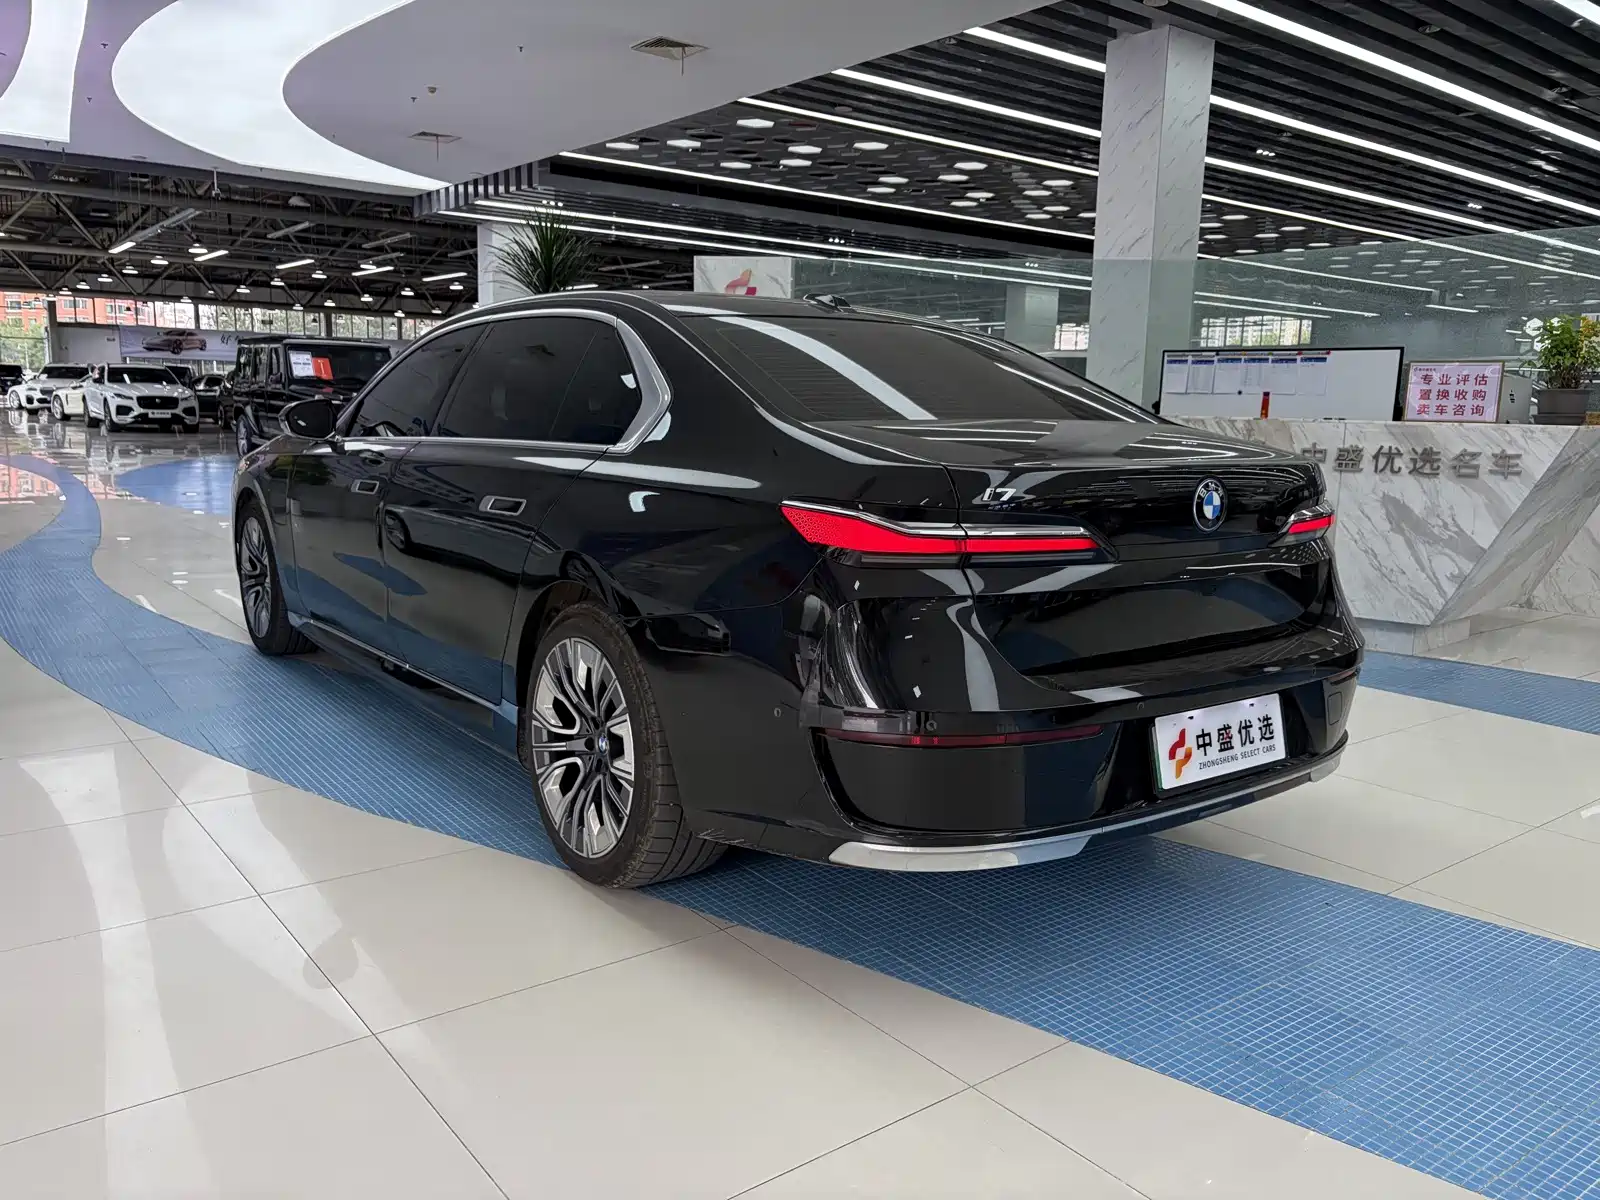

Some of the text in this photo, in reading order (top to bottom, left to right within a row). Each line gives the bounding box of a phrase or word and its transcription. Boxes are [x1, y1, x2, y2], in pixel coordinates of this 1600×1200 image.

[1420, 373, 1489, 386] 专业评估
[1418, 388, 1487, 402] 置换收购
[1416, 403, 1485, 416] 卖车咨询
[1301, 442, 1523, 480] 中盛优选名车
[982, 487, 1017, 501] i7
[1195, 713, 1275, 757] 中盛优选
[1199, 743, 1276, 770] ZHONGSHENG SELECT CARS
